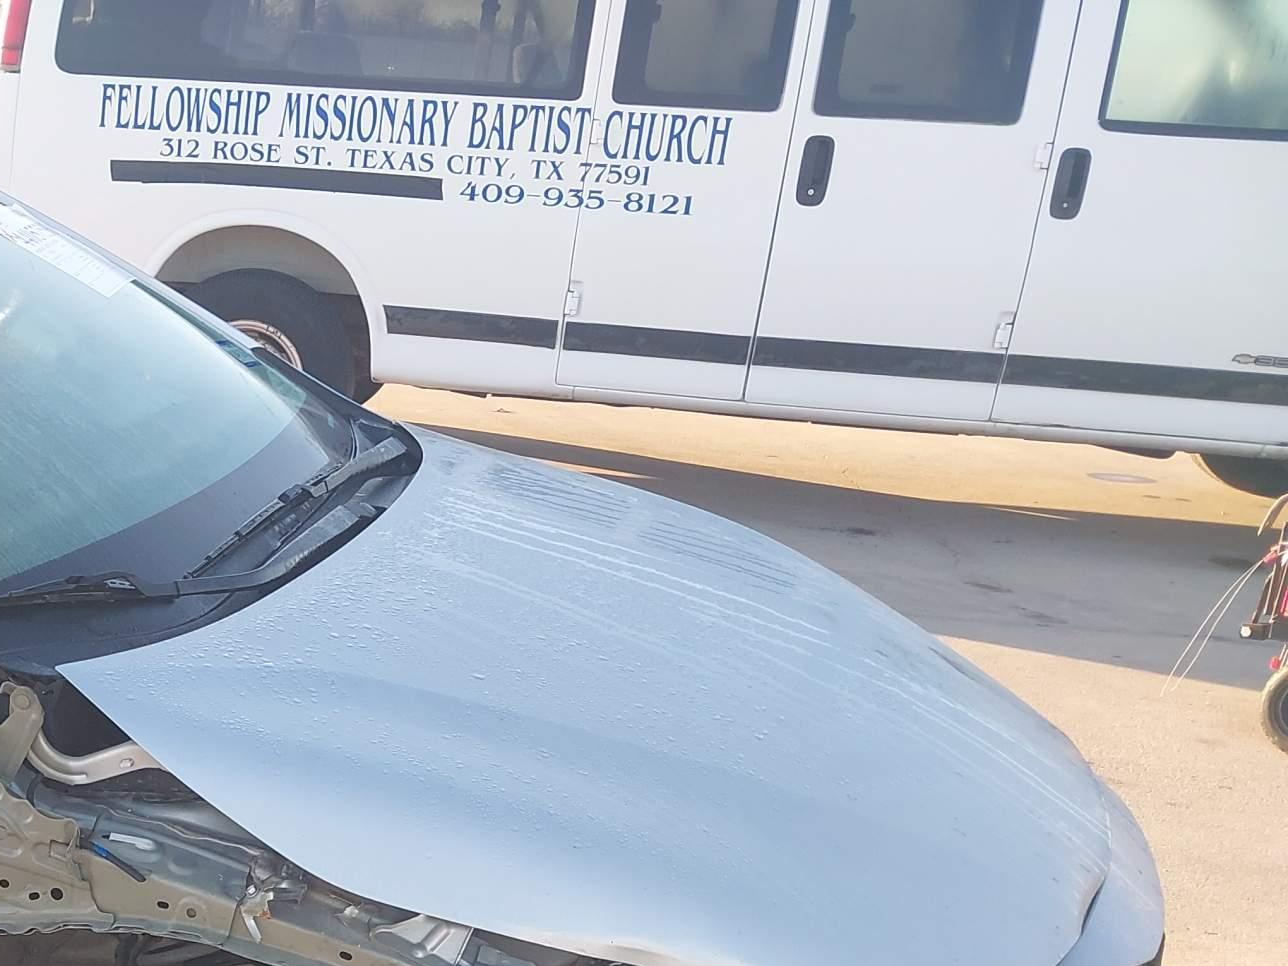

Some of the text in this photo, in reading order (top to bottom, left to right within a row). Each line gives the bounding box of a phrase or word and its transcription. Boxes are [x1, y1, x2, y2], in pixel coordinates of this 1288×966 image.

[98, 82, 733, 166] FELLOWSHIP MISSIONARY BAPTIST CHURCH
[160, 137, 650, 187] 312 ROSE ST. TEXAS CITY, TX 77591
[458, 181, 695, 216] 409-935-8121
